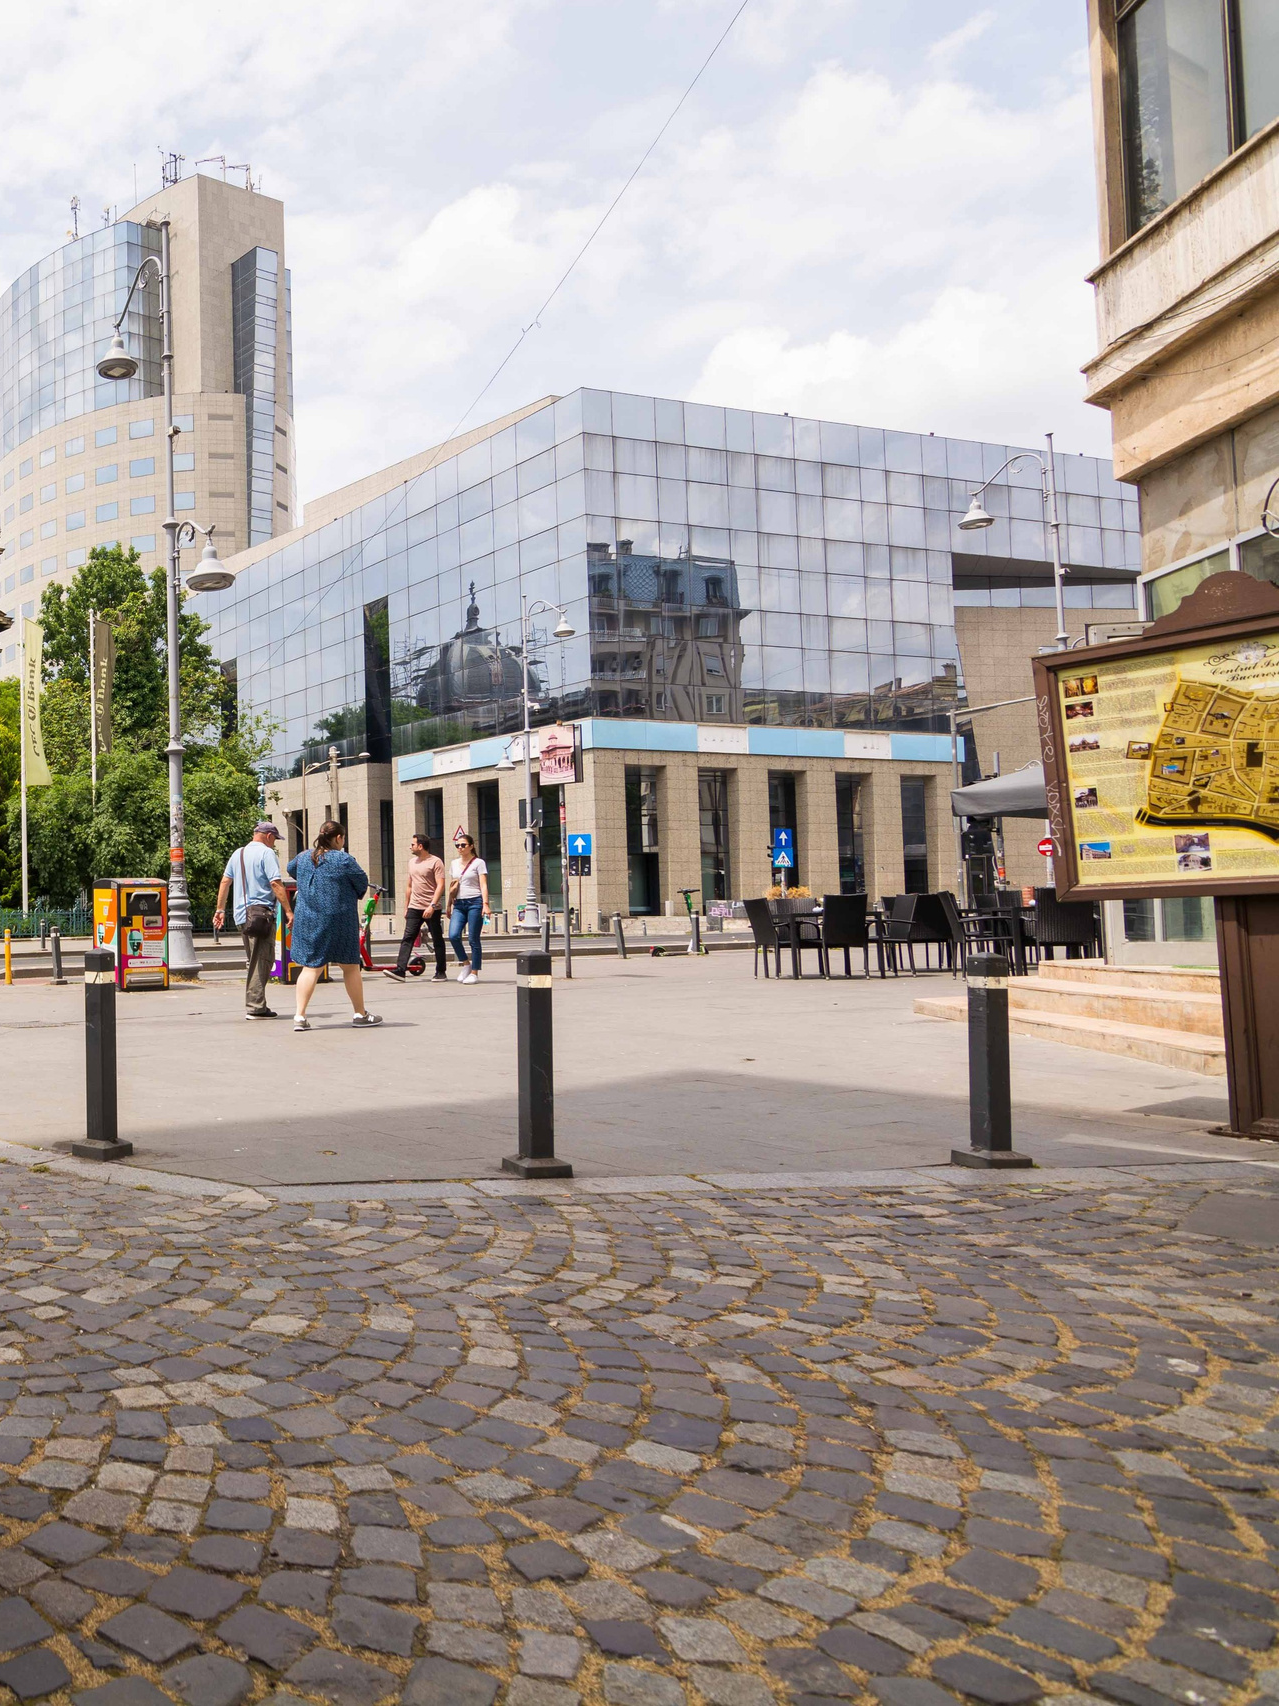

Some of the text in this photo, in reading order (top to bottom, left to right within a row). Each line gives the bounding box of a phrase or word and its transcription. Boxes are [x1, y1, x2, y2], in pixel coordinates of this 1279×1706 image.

[27, 657, 37, 701] Bank
[97, 657, 109, 700] Bank
[1210, 661, 1259, 676] Centrul
